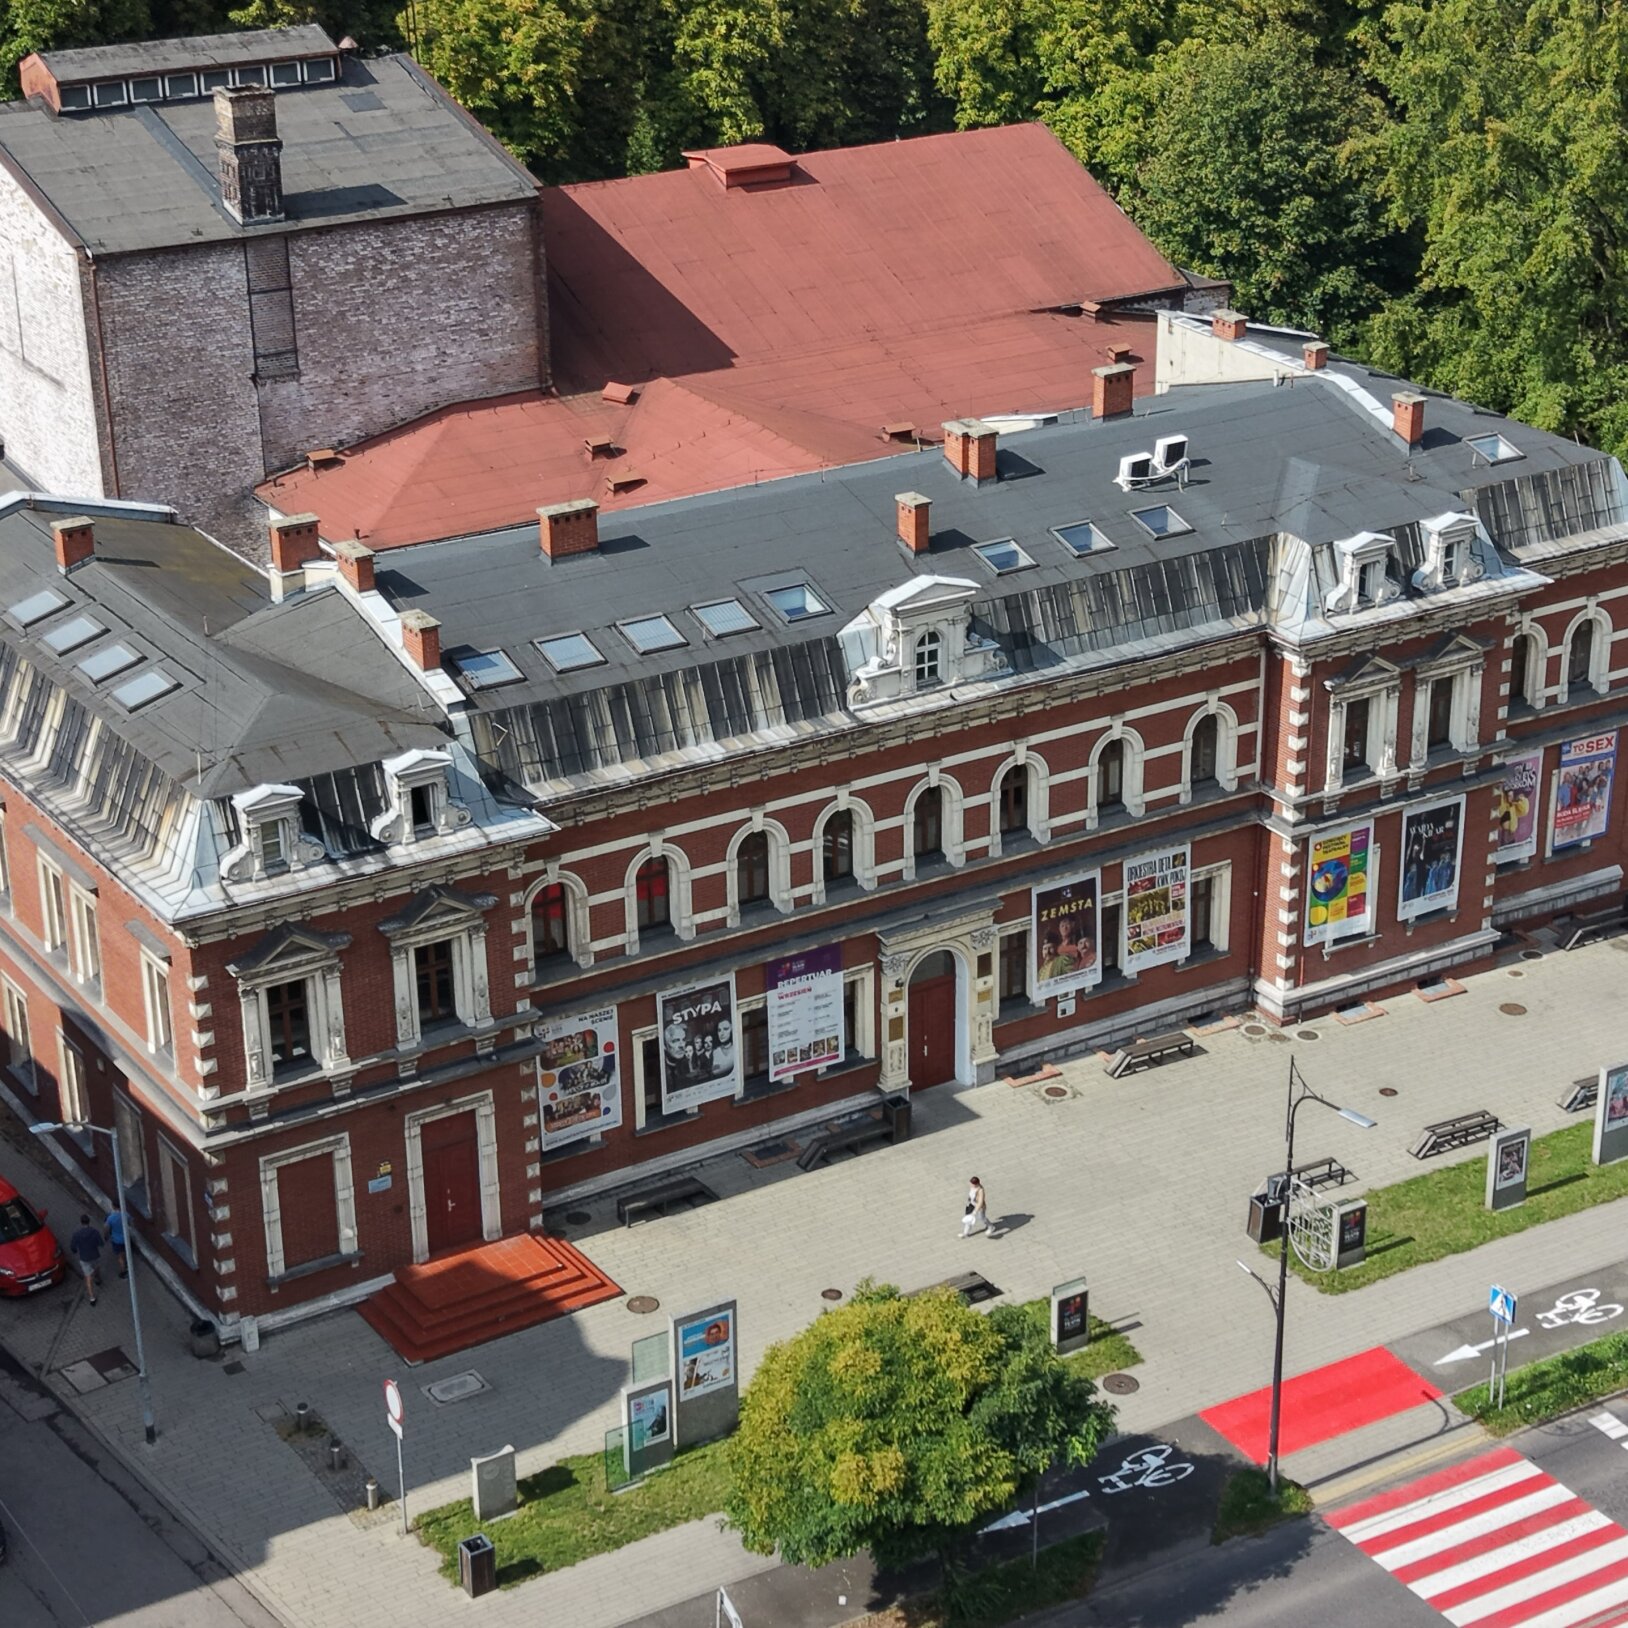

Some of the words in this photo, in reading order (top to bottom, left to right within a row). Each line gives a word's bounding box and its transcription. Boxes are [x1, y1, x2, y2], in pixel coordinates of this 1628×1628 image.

[1573, 743, 1584, 754] TO
[1585, 736, 1614, 753] SEX
[1041, 898, 1093, 921] ZEMSTA
[777, 968, 832, 988] REPERTUAR
[672, 1000, 722, 1025] STYPA
